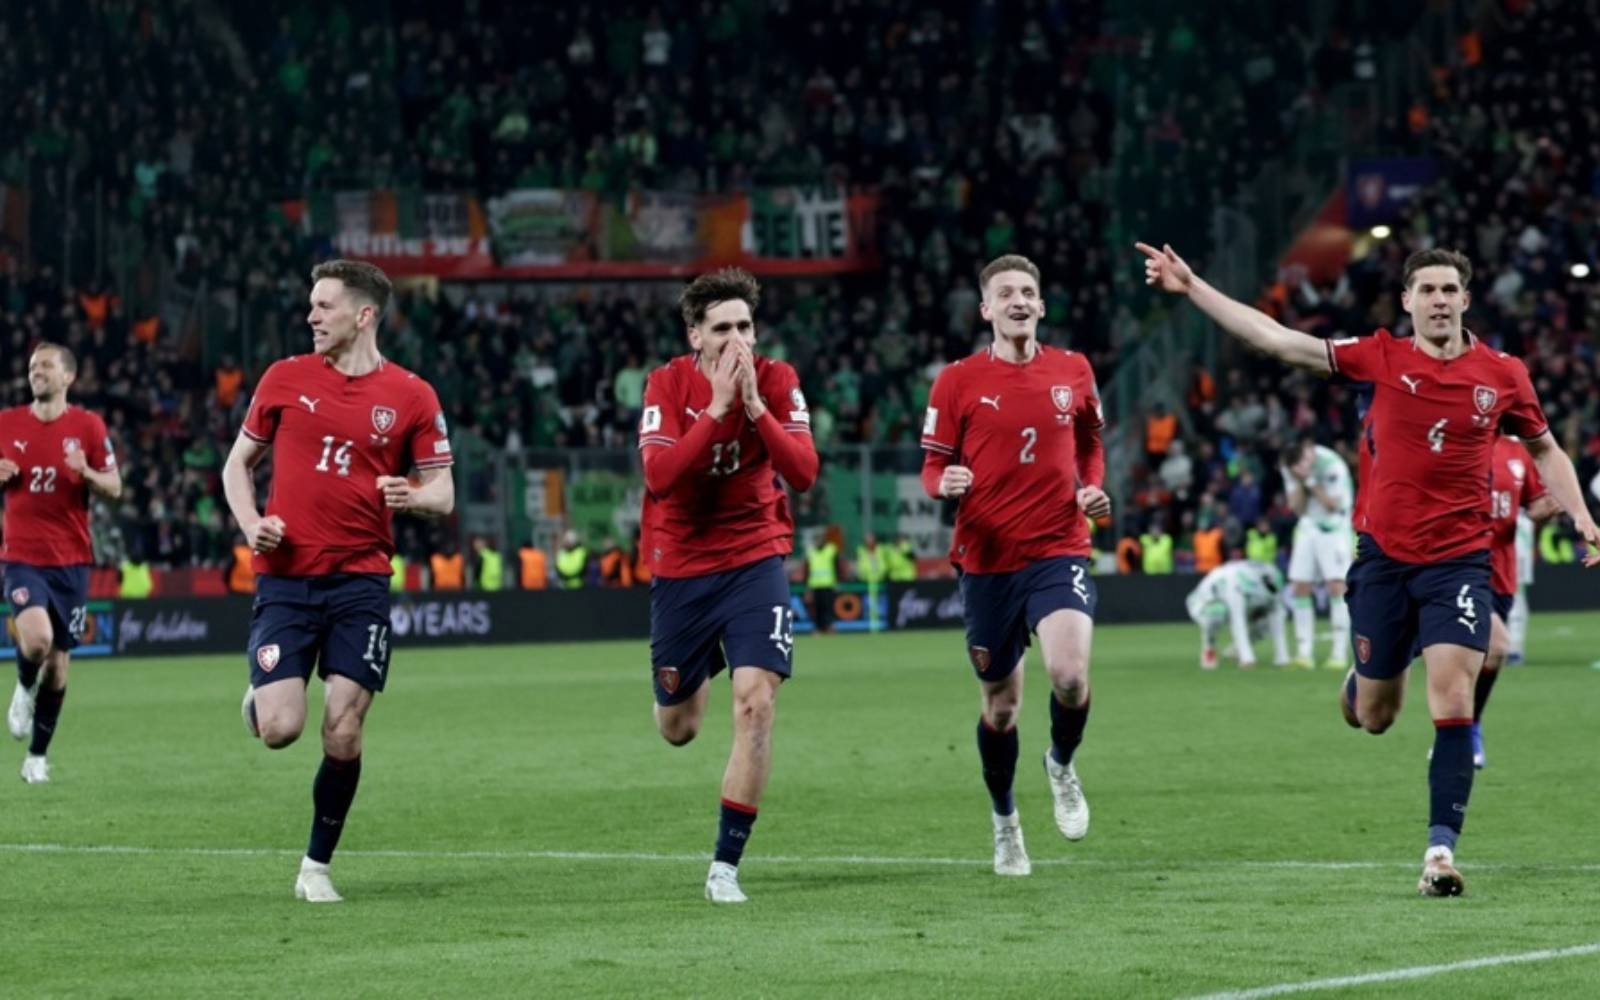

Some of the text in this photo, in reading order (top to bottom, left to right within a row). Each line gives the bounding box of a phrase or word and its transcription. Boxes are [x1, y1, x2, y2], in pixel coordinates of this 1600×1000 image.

[1019, 426, 1037, 464] 2
[1427, 418, 1449, 453] 4
[315, 435, 354, 476] 14
[706, 440, 741, 476] 13
[29, 466, 57, 493] 22
[1070, 564, 1086, 591] 2
[411, 600, 491, 636] YEARS
[1456, 584, 1476, 618] 4
[118, 609, 143, 653] for
[362, 623, 388, 662] 14
[769, 605, 794, 644] 13
